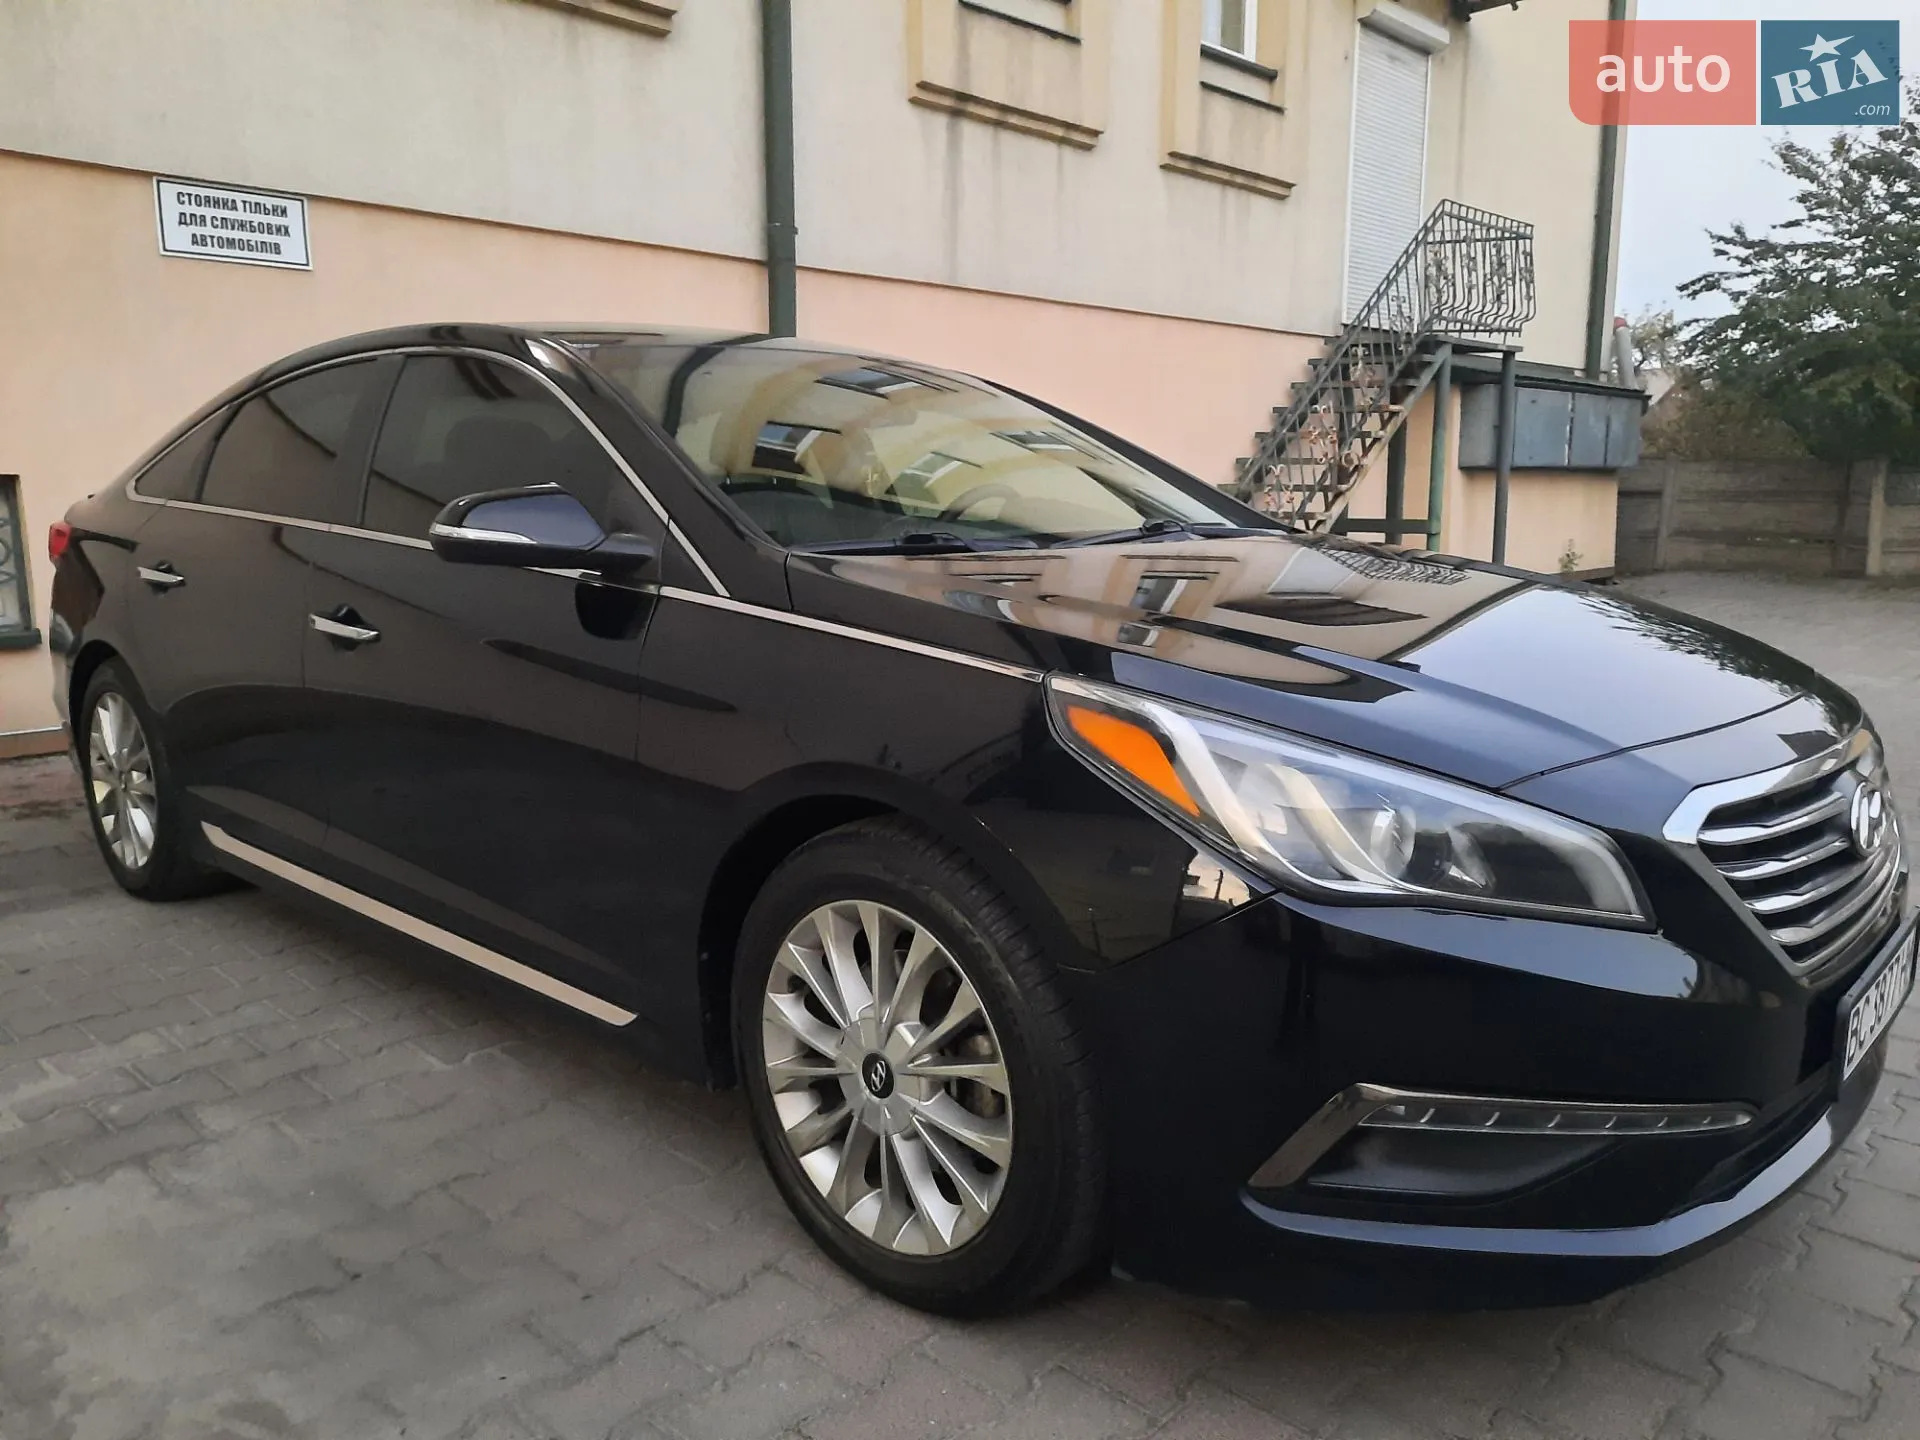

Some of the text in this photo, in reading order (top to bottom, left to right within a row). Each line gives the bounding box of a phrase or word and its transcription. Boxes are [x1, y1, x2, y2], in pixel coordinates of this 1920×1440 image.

[176, 191, 288, 218] СТОЯНКА ТІЛЬКИ
[178, 211, 291, 238] ДЛЯ СЛУЖБОВИХ
[191, 233, 282, 255] АВТОМОБІЛІВ
